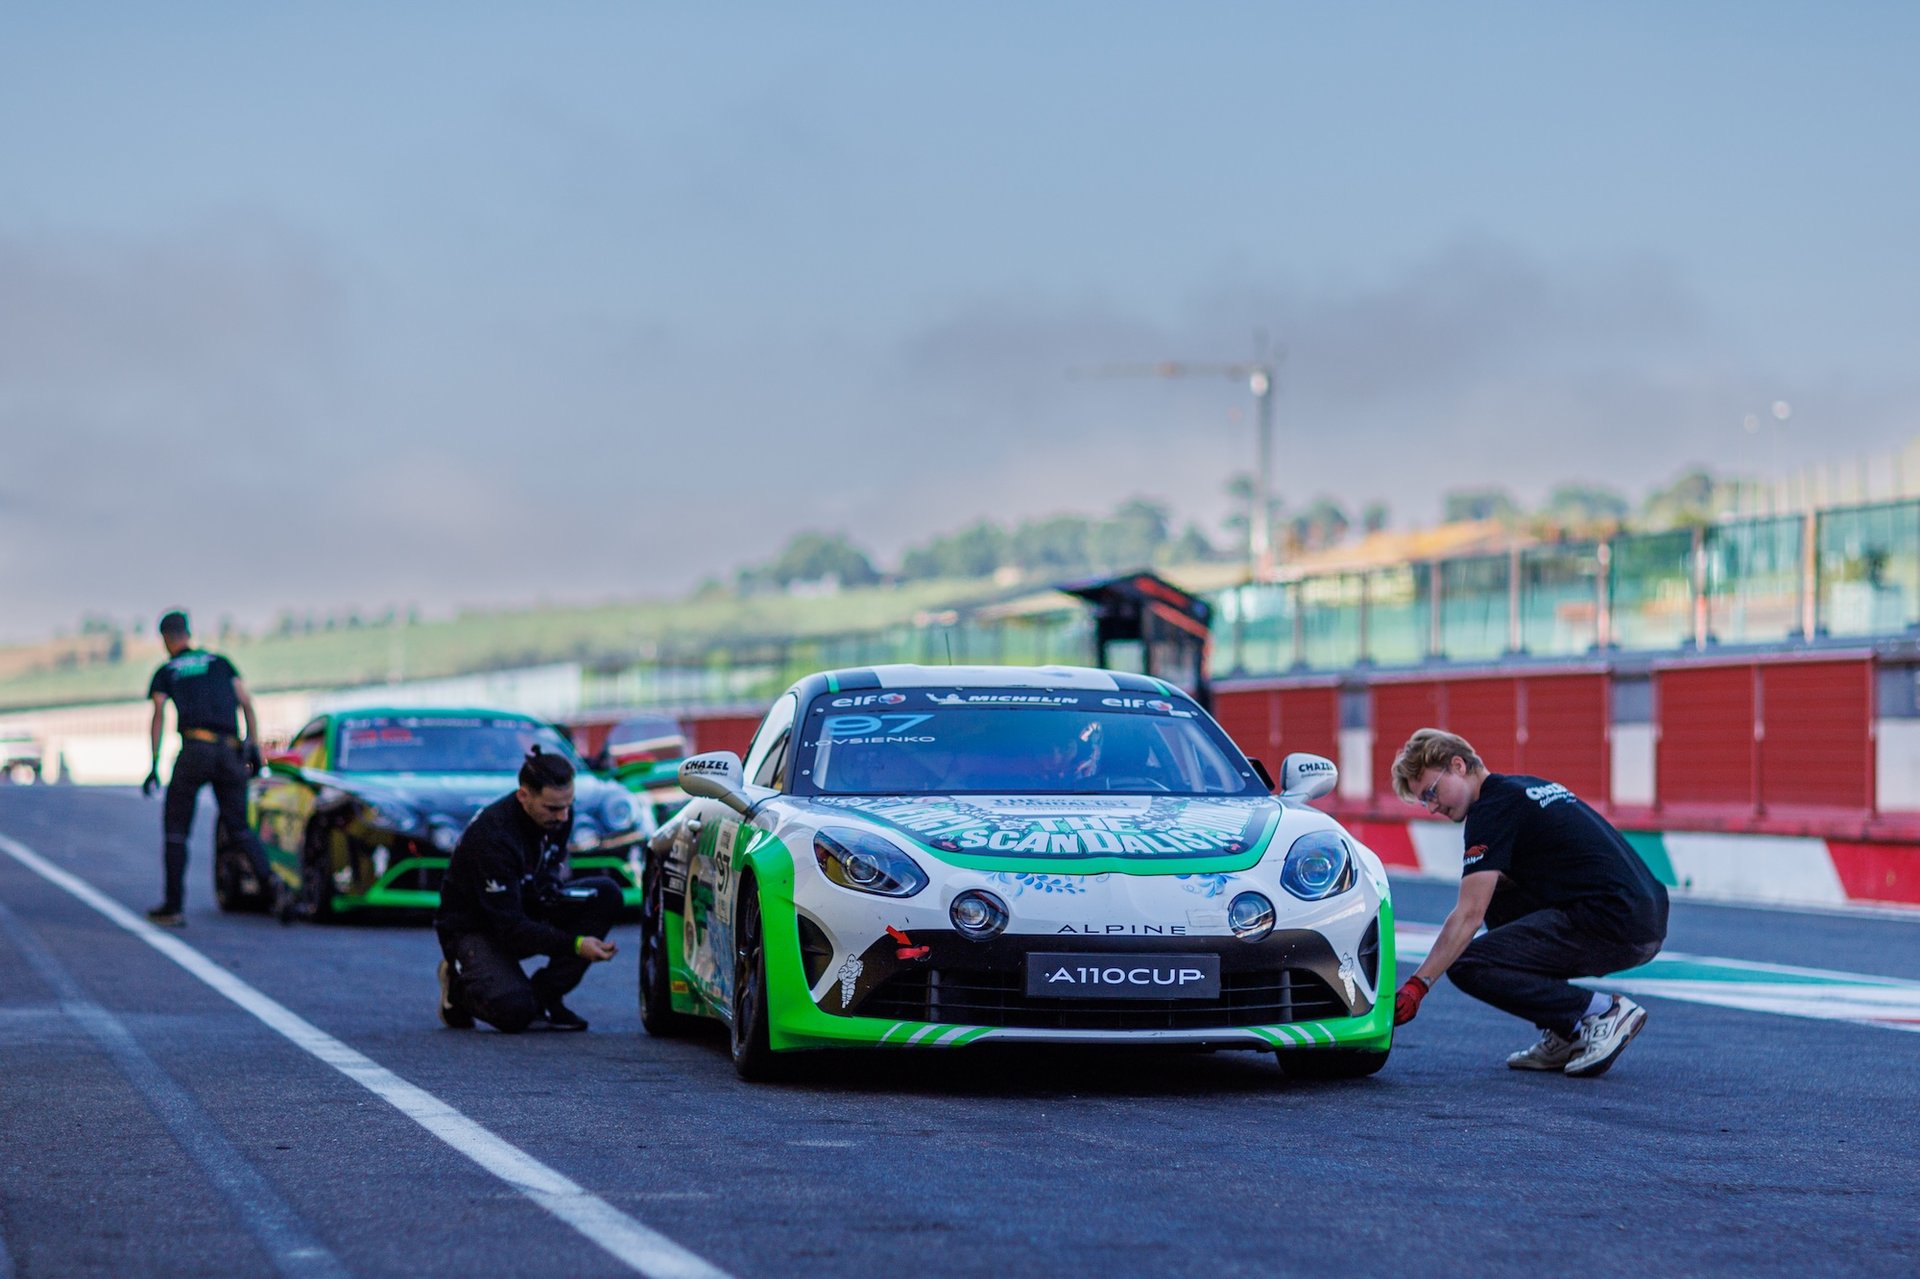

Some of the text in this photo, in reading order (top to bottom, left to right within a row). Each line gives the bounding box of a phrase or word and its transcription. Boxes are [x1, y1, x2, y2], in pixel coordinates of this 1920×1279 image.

[832, 695, 877, 707] elf
[968, 695, 1079, 704] MICHELIN
[1102, 698, 1144, 708] elf
[826, 714, 935, 736] 97
[804, 736, 935, 747] I.OVSIENKO
[685, 760, 729, 770] CHAZEL
[1299, 762, 1334, 772] CHAZ
[1025, 815, 1141, 833] THE
[959, 829, 1225, 853] SCANDALIST
[1057, 924, 1186, 935] ALPINE
